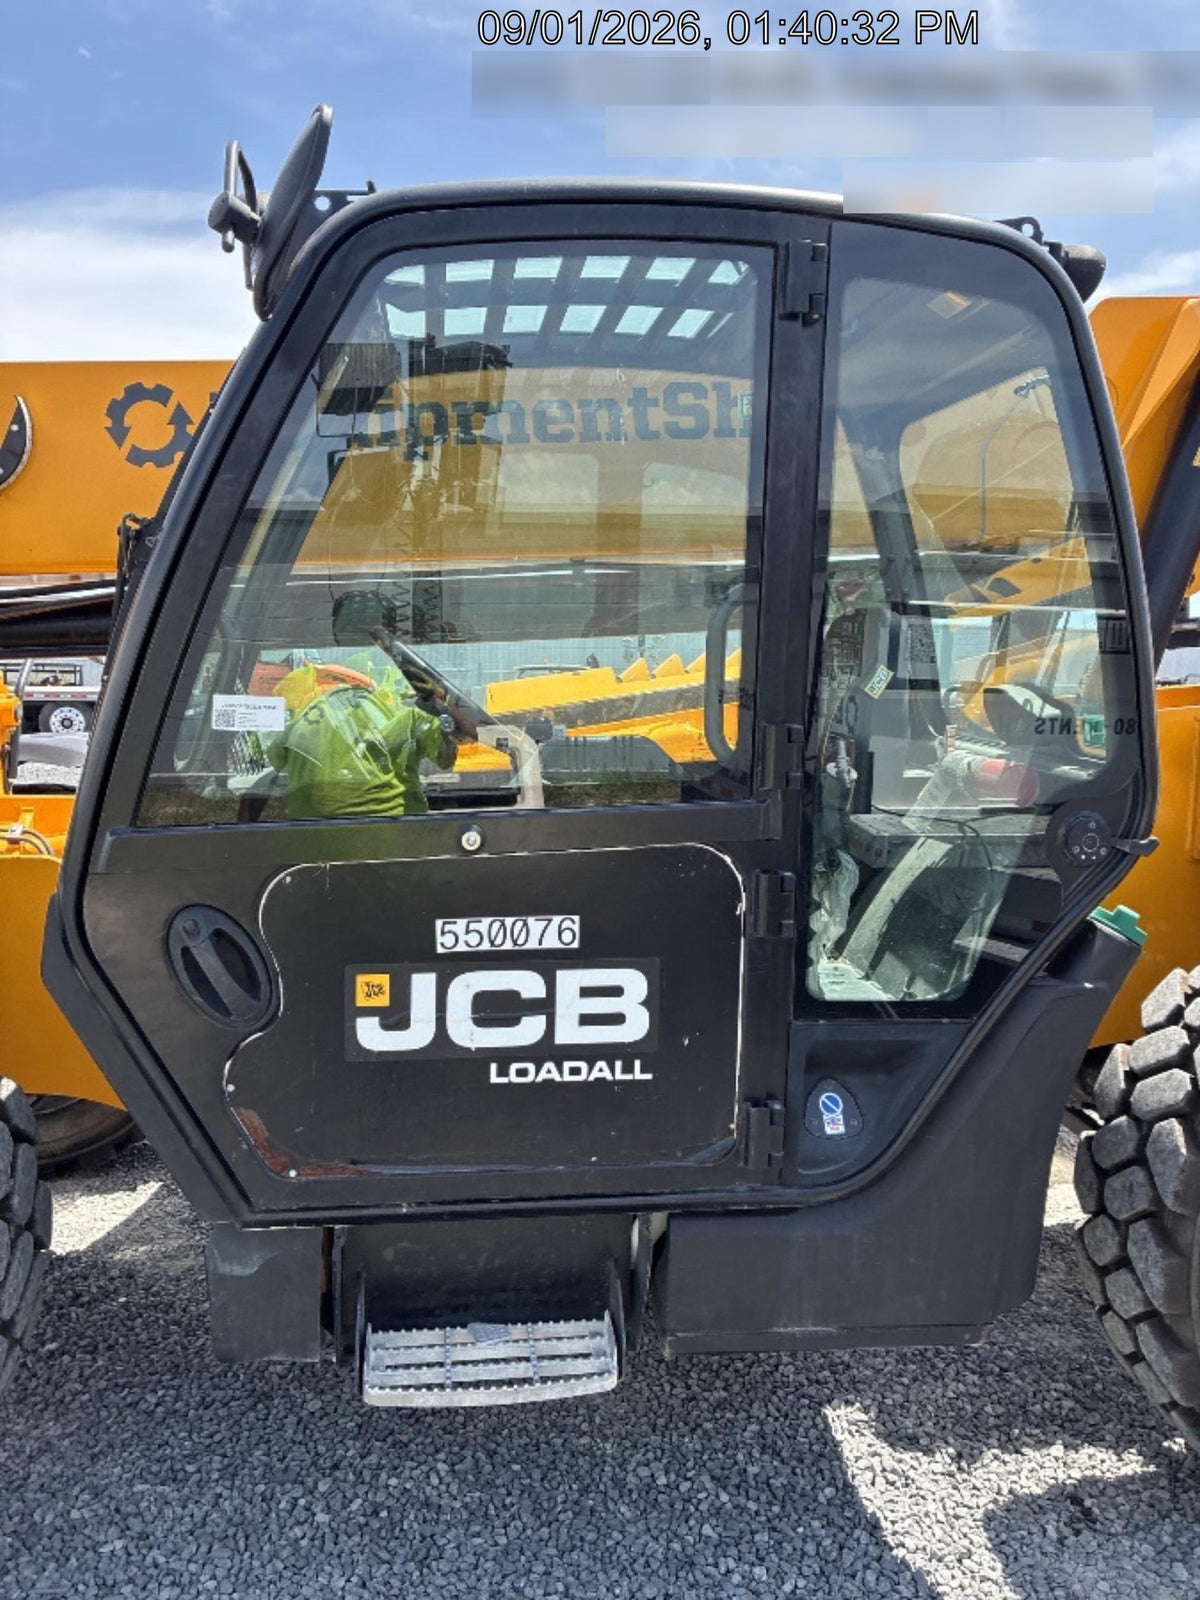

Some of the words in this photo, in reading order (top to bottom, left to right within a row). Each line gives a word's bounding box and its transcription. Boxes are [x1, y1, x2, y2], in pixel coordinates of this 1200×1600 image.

[438, 916, 578, 950] 550076
[355, 968, 650, 1052] JCB
[489, 1059, 653, 1084] LOADALL
